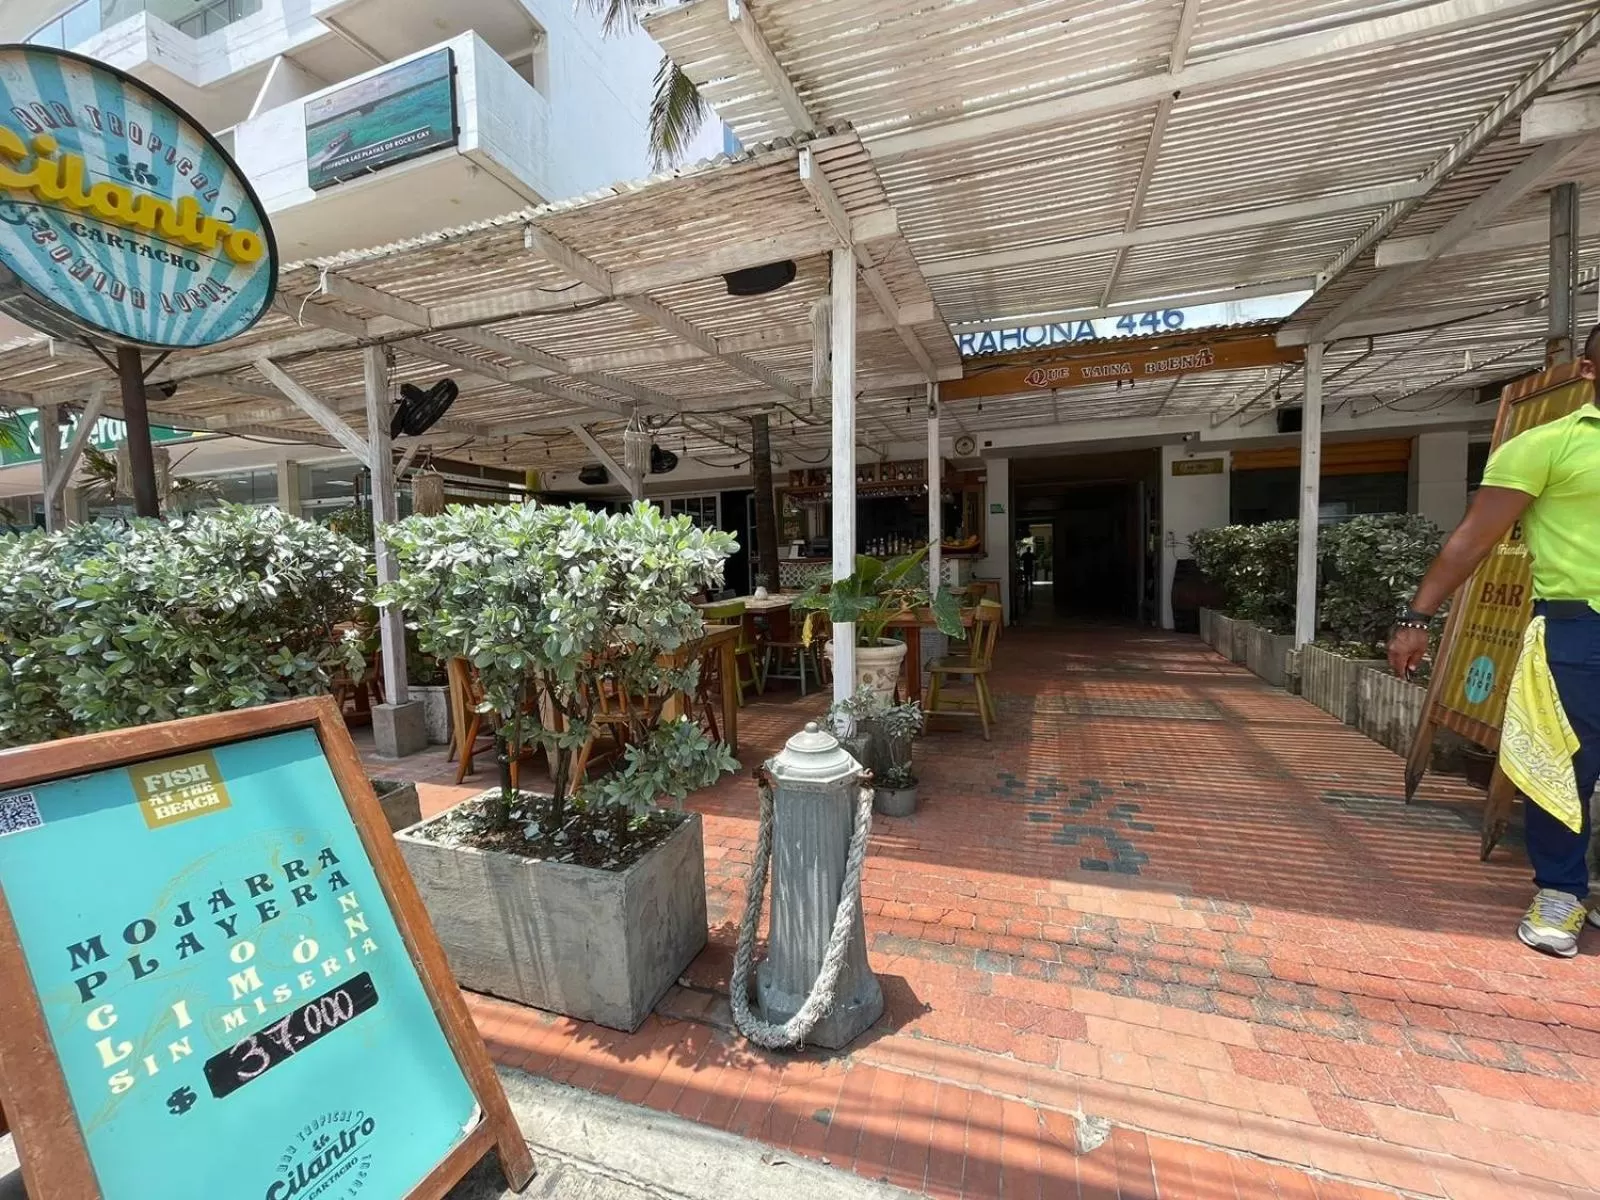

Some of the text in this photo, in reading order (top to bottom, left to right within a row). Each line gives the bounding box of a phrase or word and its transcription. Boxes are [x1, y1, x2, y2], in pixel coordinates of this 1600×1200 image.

[85, 104, 220, 203] TROPICAL
[0, 123, 264, 265] Cilantro
[70, 221, 201, 273] CARTACHO
[31, 228, 233, 315] COMIDA LOCAL
[1116, 308, 1185, 335] 446
[1081, 361, 1133, 379] VAINA
[1145, 347, 1215, 374] BUENA
[1480, 581, 1525, 608] BAR
[143, 763, 211, 793] FISH
[147, 780, 214, 807] AT THE
[153, 792, 221, 820] BEACH
[66, 847, 340, 972] MOJARRA
[74, 870, 350, 1004] PLAYERA
[108, 937, 379, 1095] SIN MISERIA
[165, 1085, 199, 1117] $
[265, 1116, 376, 1200] Cilantro
[308, 1156, 359, 1200] CARTACHO
